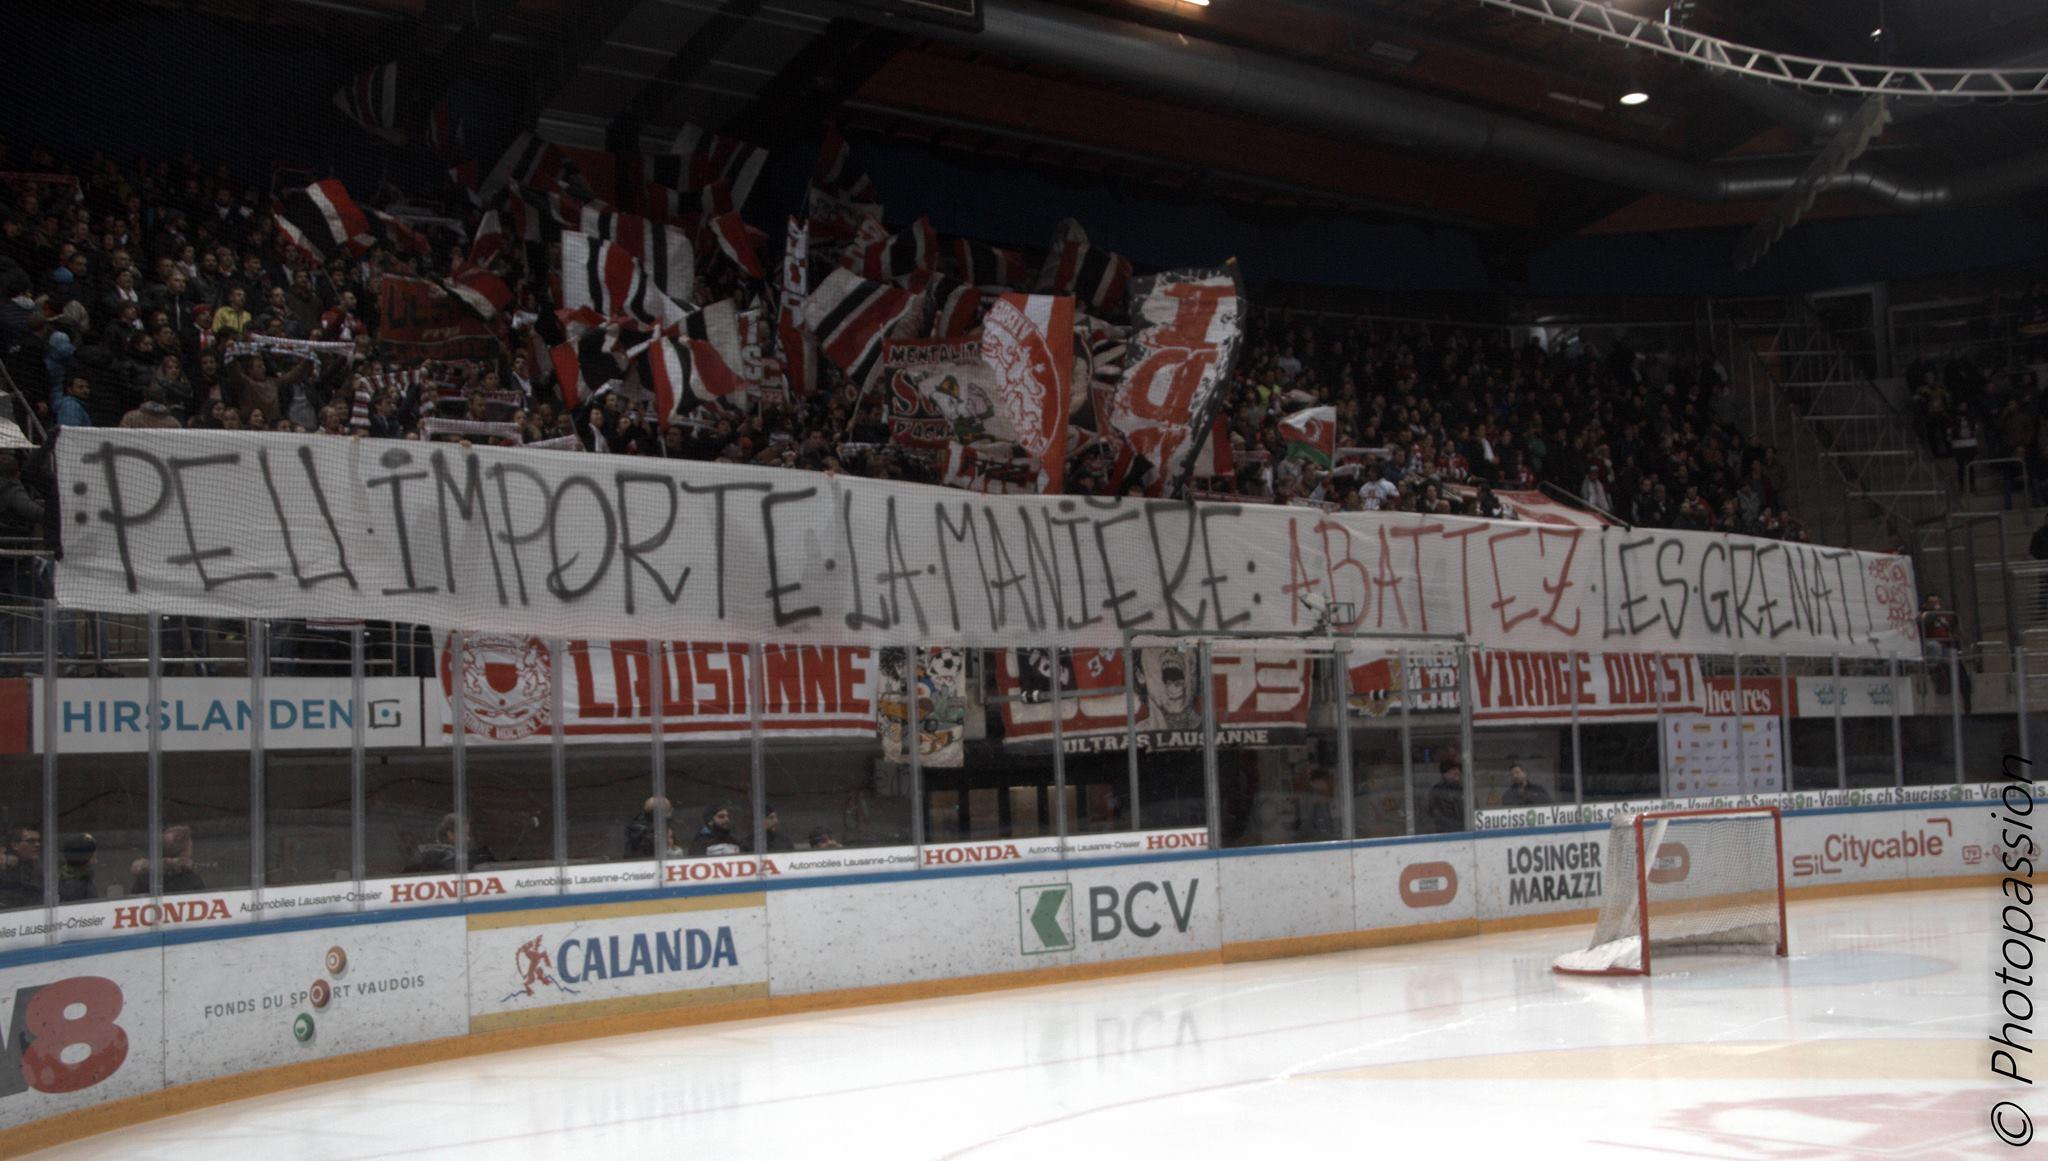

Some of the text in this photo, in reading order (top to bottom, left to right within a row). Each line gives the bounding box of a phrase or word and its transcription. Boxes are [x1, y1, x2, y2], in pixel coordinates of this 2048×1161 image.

[845, 489, 929, 634] LA
[1281, 517, 1584, 637] ABATTEZ
[1600, 535, 1689, 640] LES
[569, 640, 870, 718] LAUSANNE
[1472, 651, 1597, 708] VIRAGE
[1706, 682, 1771, 713] heures
[62, 699, 353, 733] HIRSLANDEN
[788, 855, 919, 871] Automobiles Lausanne-Crissier
[923, 844, 1022, 866] HONDA
[1028, 839, 1141, 856] Automobiles Lausanne-Crissier
[1507, 841, 1602, 875] LOSINGER
[1825, 829, 1943, 867] Citycable
[514, 871, 656, 890] Automobiles Lausanne-Crissier
[665, 858, 781, 882] HONDA
[240, 890, 382, 913] Automobiles Lausanne-Crissier
[389, 877, 507, 904] HONDA
[1508, 871, 1602, 905] MARAZZI
[112, 898, 232, 929] HONDA
[1088, 878, 1199, 943] BCV
[557, 926, 738, 985] CALANDA
[204, 997, 257, 1020] FONDS
[263, 995, 285, 1011] DU
[357, 974, 426, 996] VAUDOIS
